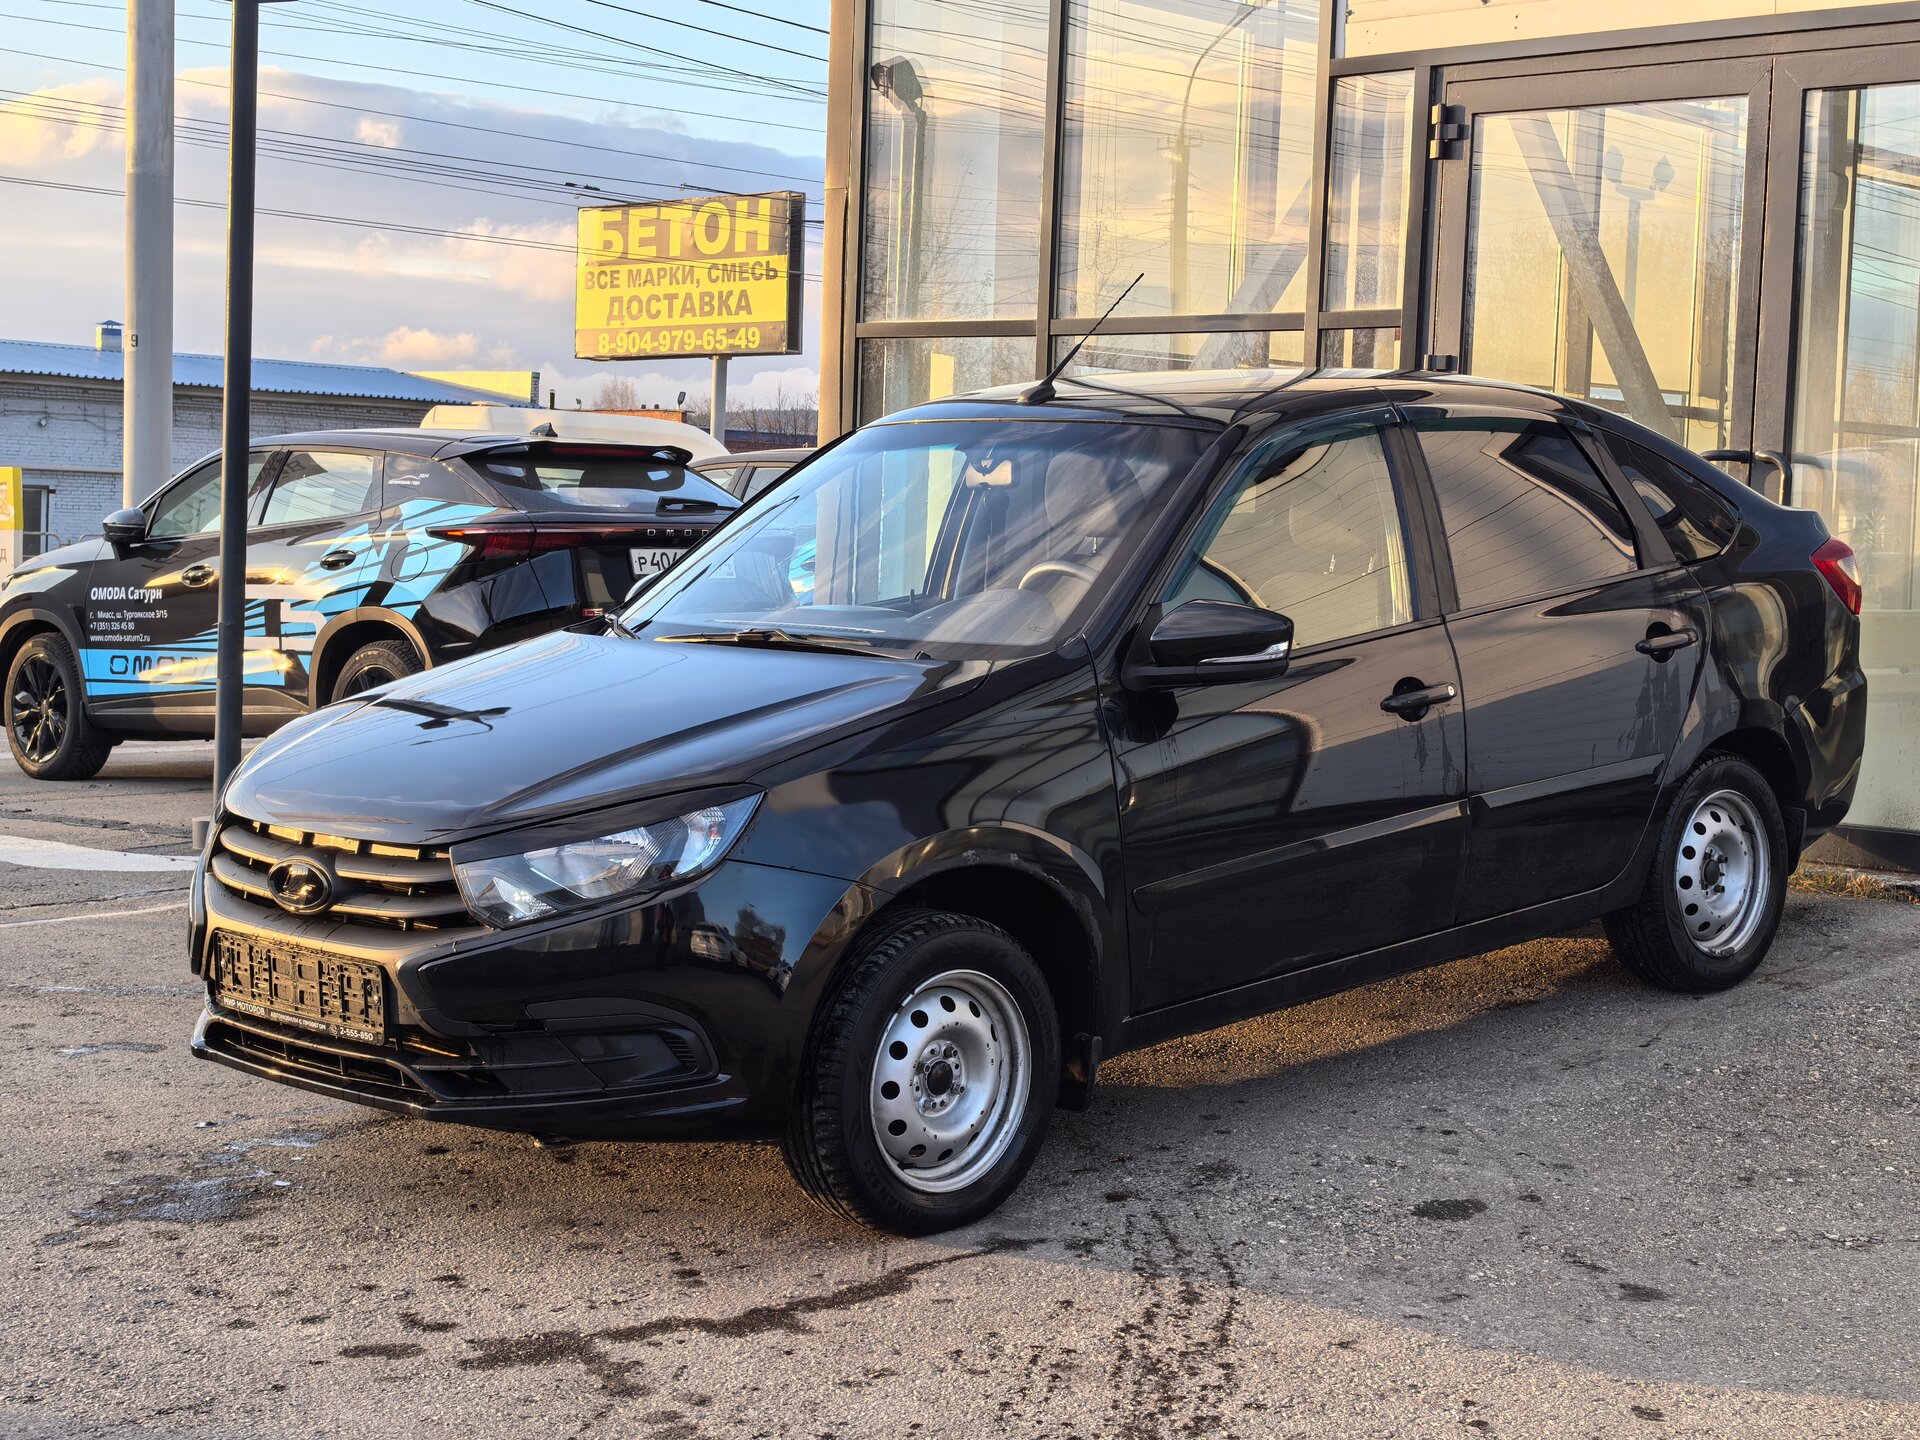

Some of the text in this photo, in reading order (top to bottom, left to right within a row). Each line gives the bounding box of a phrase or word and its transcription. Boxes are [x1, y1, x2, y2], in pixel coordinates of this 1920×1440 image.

[588, 199, 771, 261] БЕТОН
[584, 260, 779, 290] ВСЕ МАРКИ, СМЕСЬ
[606, 289, 752, 326] ДОСТАВКА
[131, 334, 139, 347] 9
[598, 326, 761, 354] 8-904-979-65-49
[647, 528, 709, 537] OMOD
[90, 586, 163, 604] OMODA Сатурн
[155, 609, 168, 619] 3/15
[90, 622, 97, 630] +7
[97, 622, 111, 631] (351)
[223, 996, 236, 1008] МИР
[236, 1000, 266, 1016] МОТОРОВ
